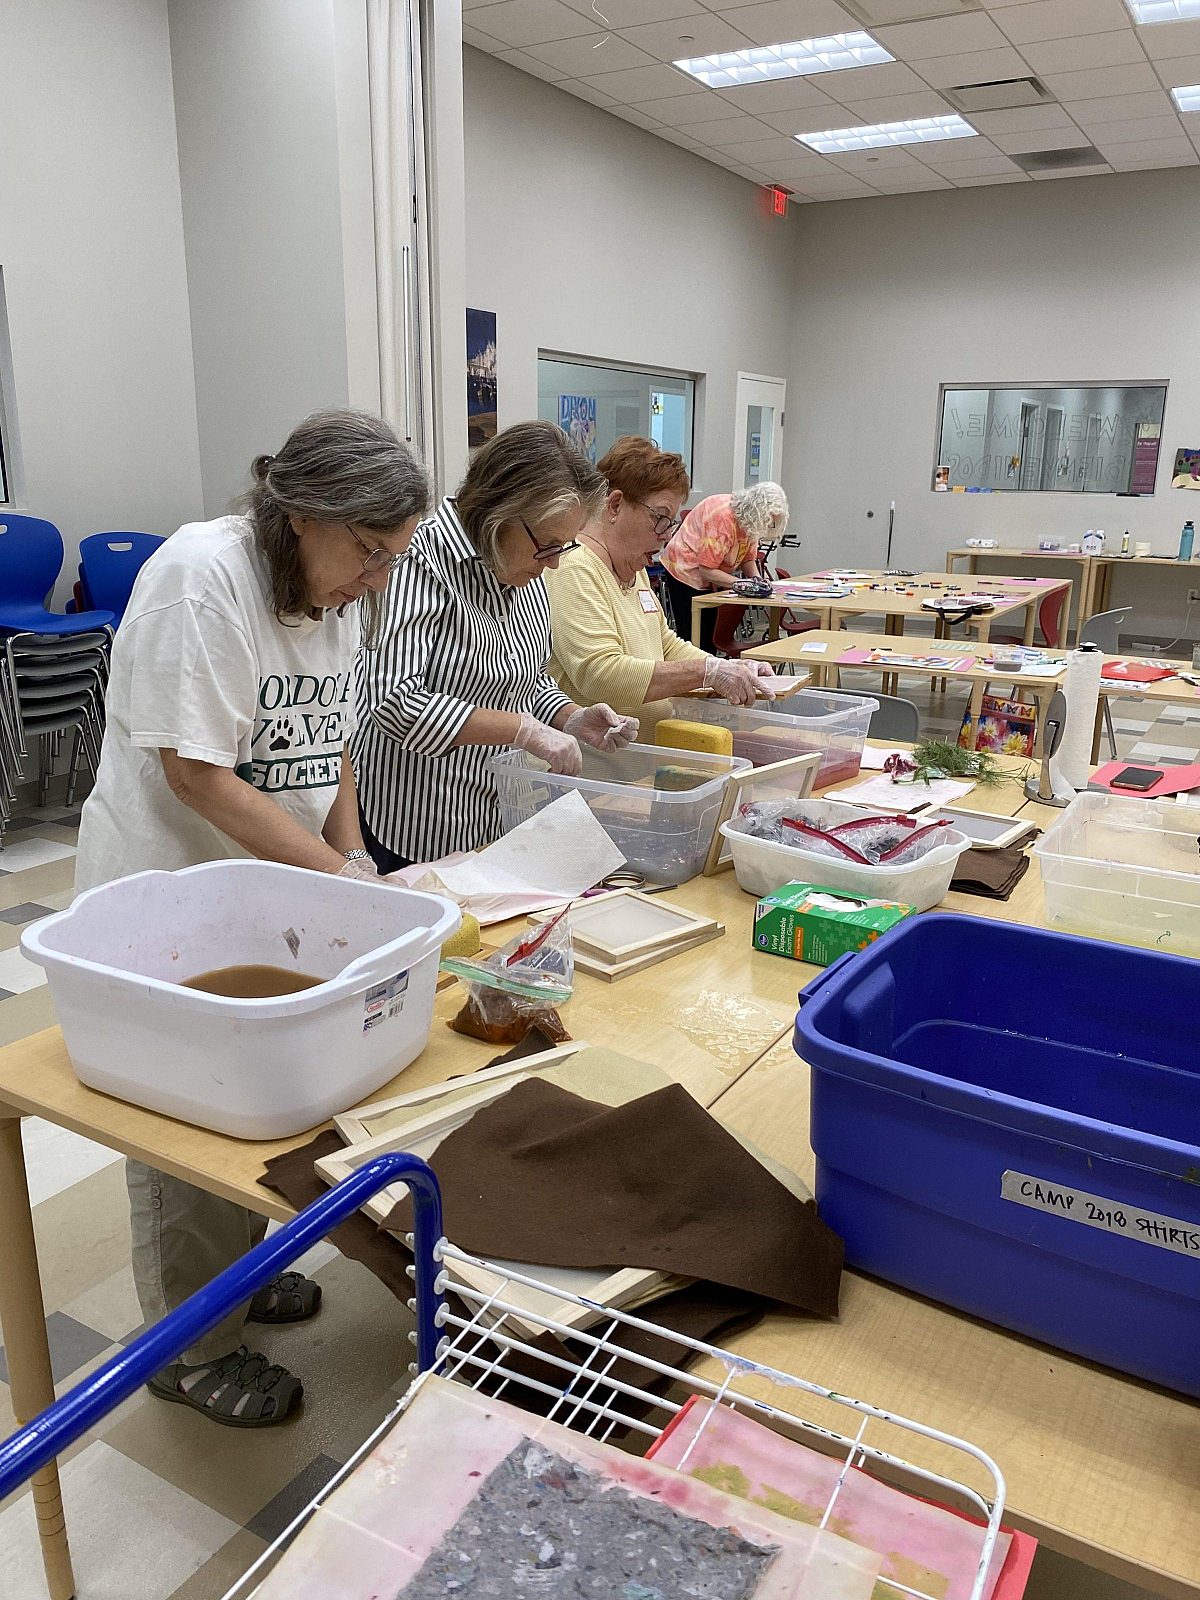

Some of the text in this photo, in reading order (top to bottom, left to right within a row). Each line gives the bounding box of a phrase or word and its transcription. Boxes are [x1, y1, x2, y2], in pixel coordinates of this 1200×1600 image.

[561, 395, 596, 421] DIXON
[779, 917, 787, 952] Disposable
[787, 914, 795, 936] Gloves
[772, 934, 780, 950] Vinyl
[1021, 1181, 1074, 1210] CAMP
[1085, 1202, 1127, 1228] 2018
